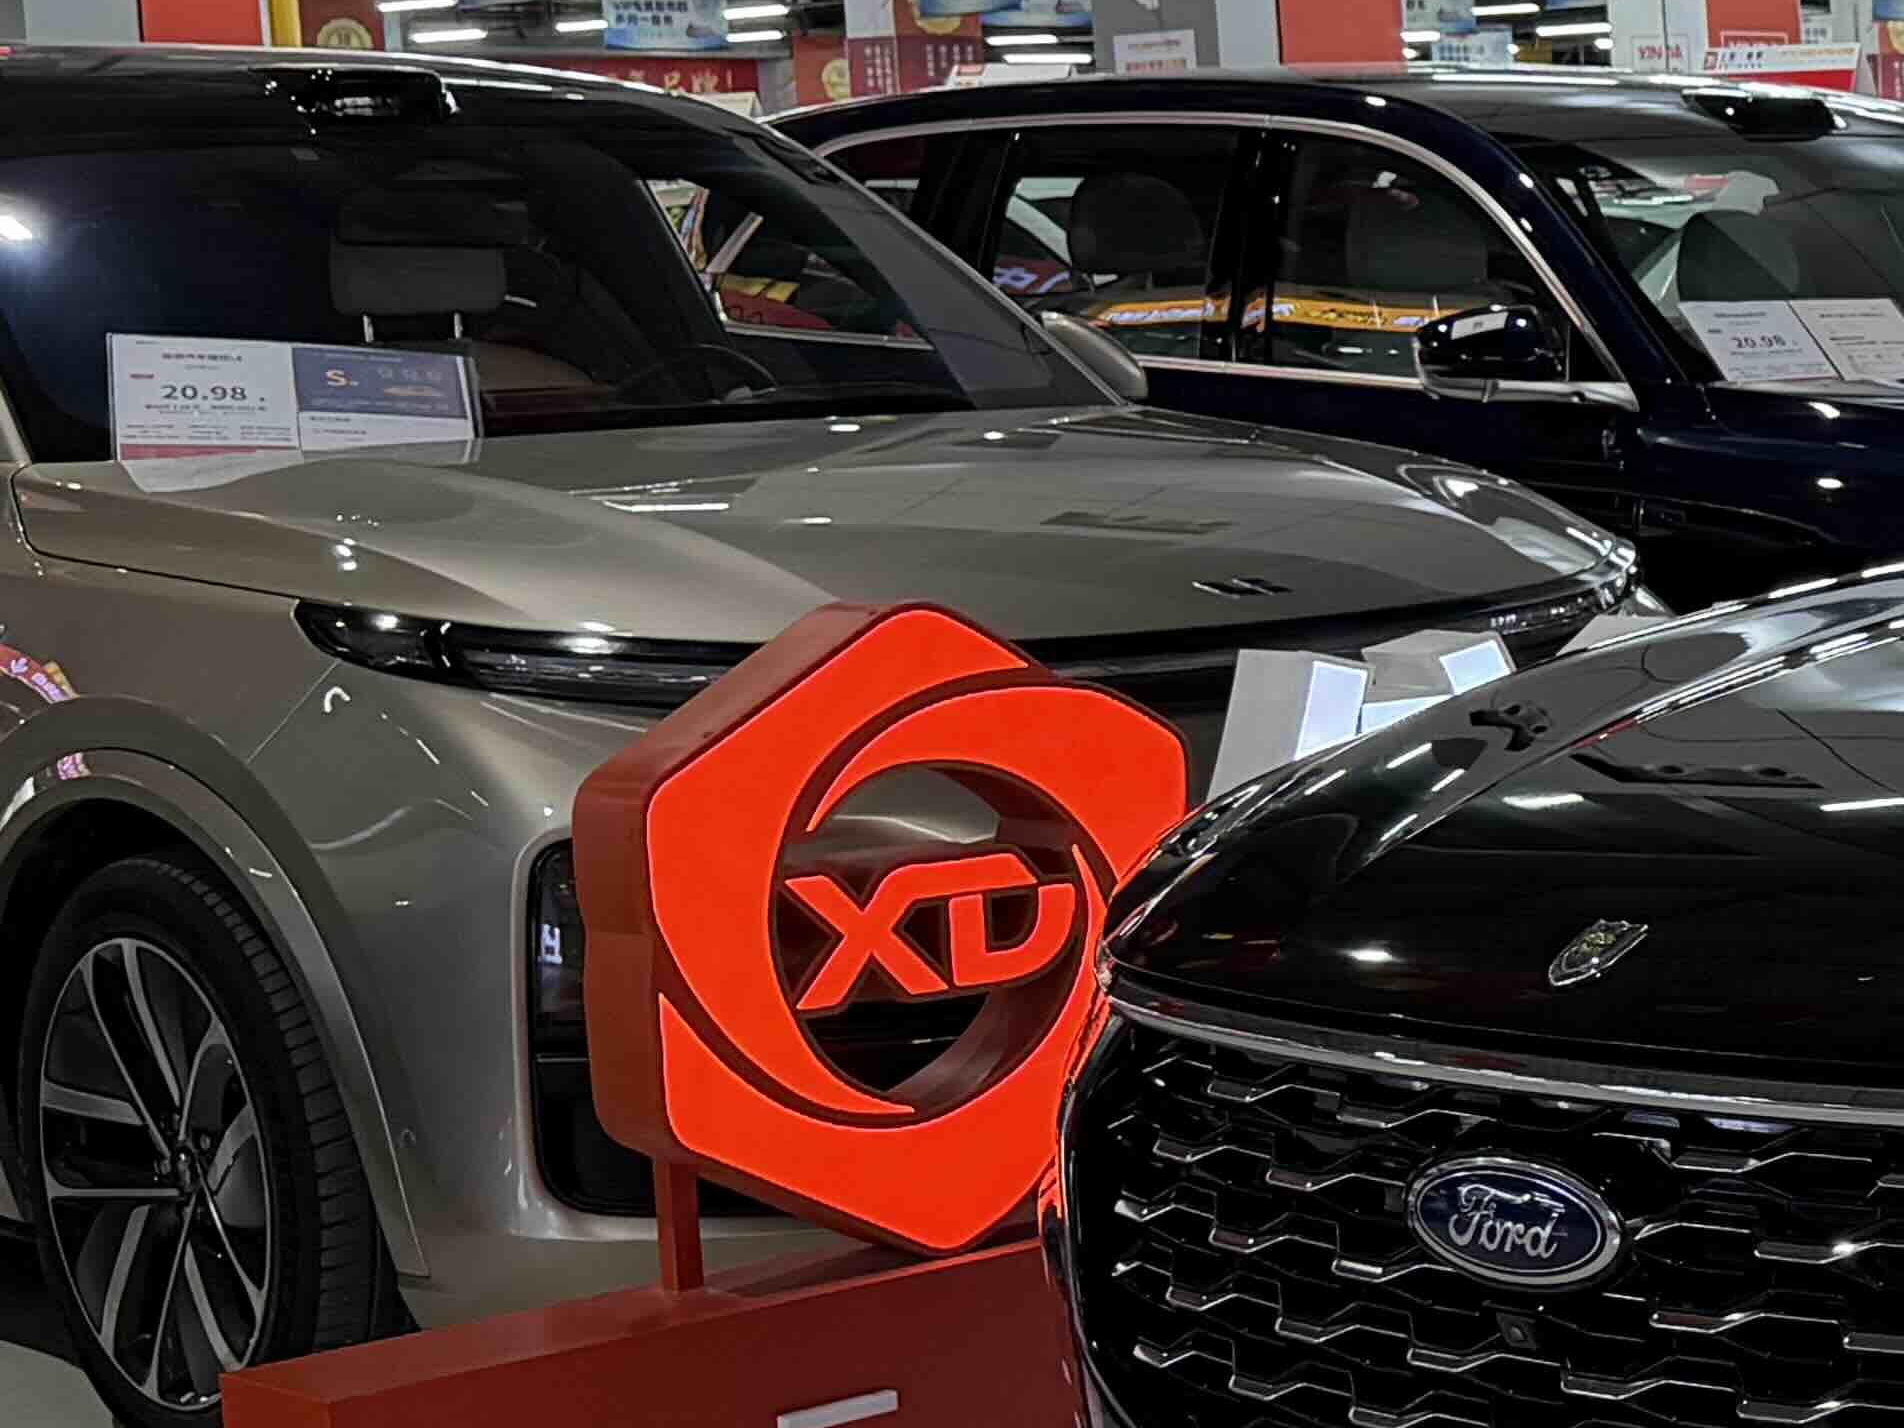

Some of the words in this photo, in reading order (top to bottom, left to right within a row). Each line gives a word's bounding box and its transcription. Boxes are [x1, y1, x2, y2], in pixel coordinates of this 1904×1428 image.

[161, 382, 248, 402] 20.98
[784, 851, 1076, 1010] XD
[1448, 1183, 1564, 1261] Ford
